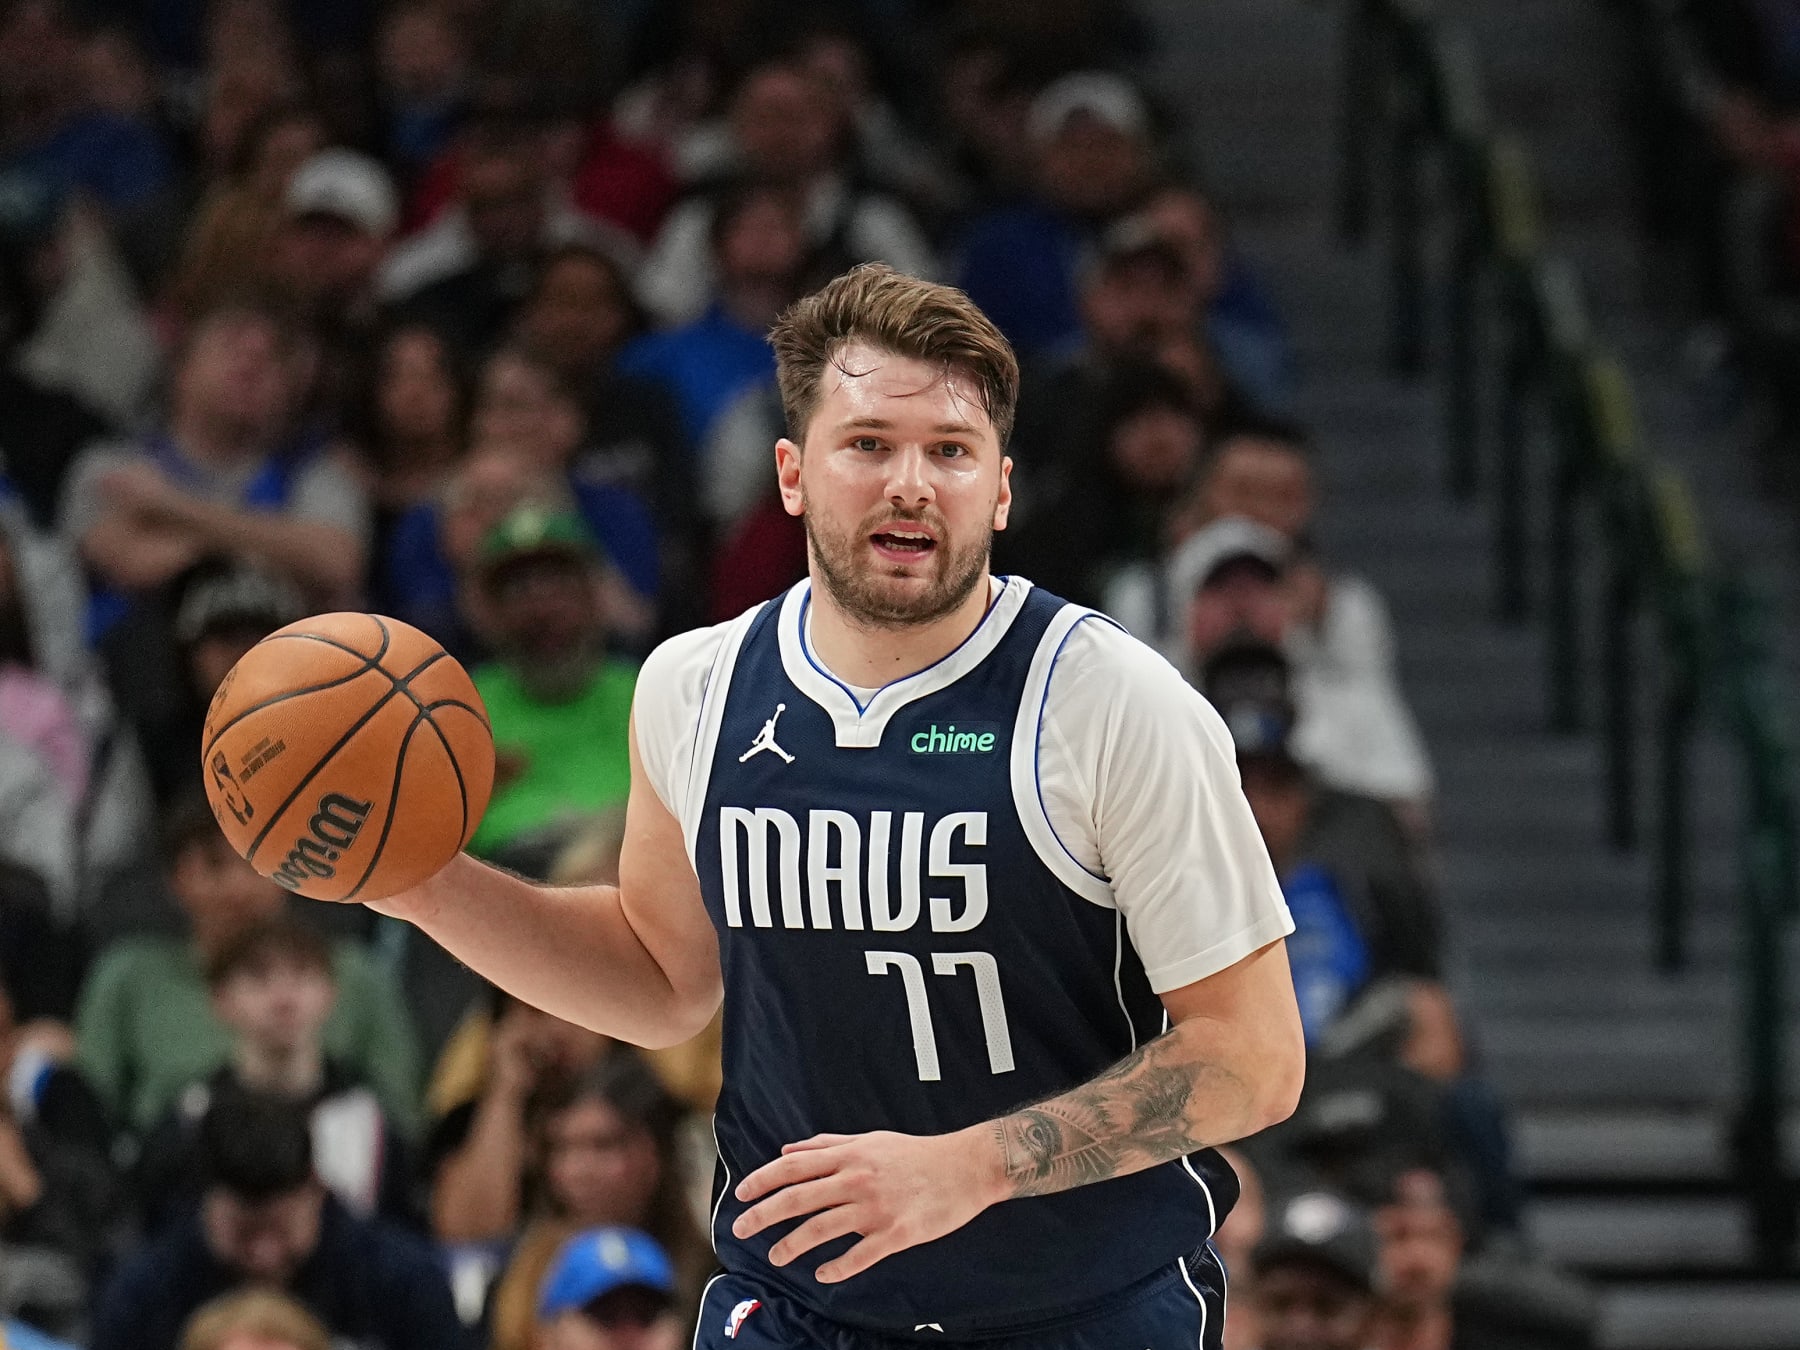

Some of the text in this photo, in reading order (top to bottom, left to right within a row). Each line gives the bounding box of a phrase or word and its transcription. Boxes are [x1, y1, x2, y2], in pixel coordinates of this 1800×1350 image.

[911, 724, 996, 753] chime
[272, 791, 376, 890] Wilso
[719, 806, 989, 933] MAVS
[864, 950, 1016, 1082] 77
